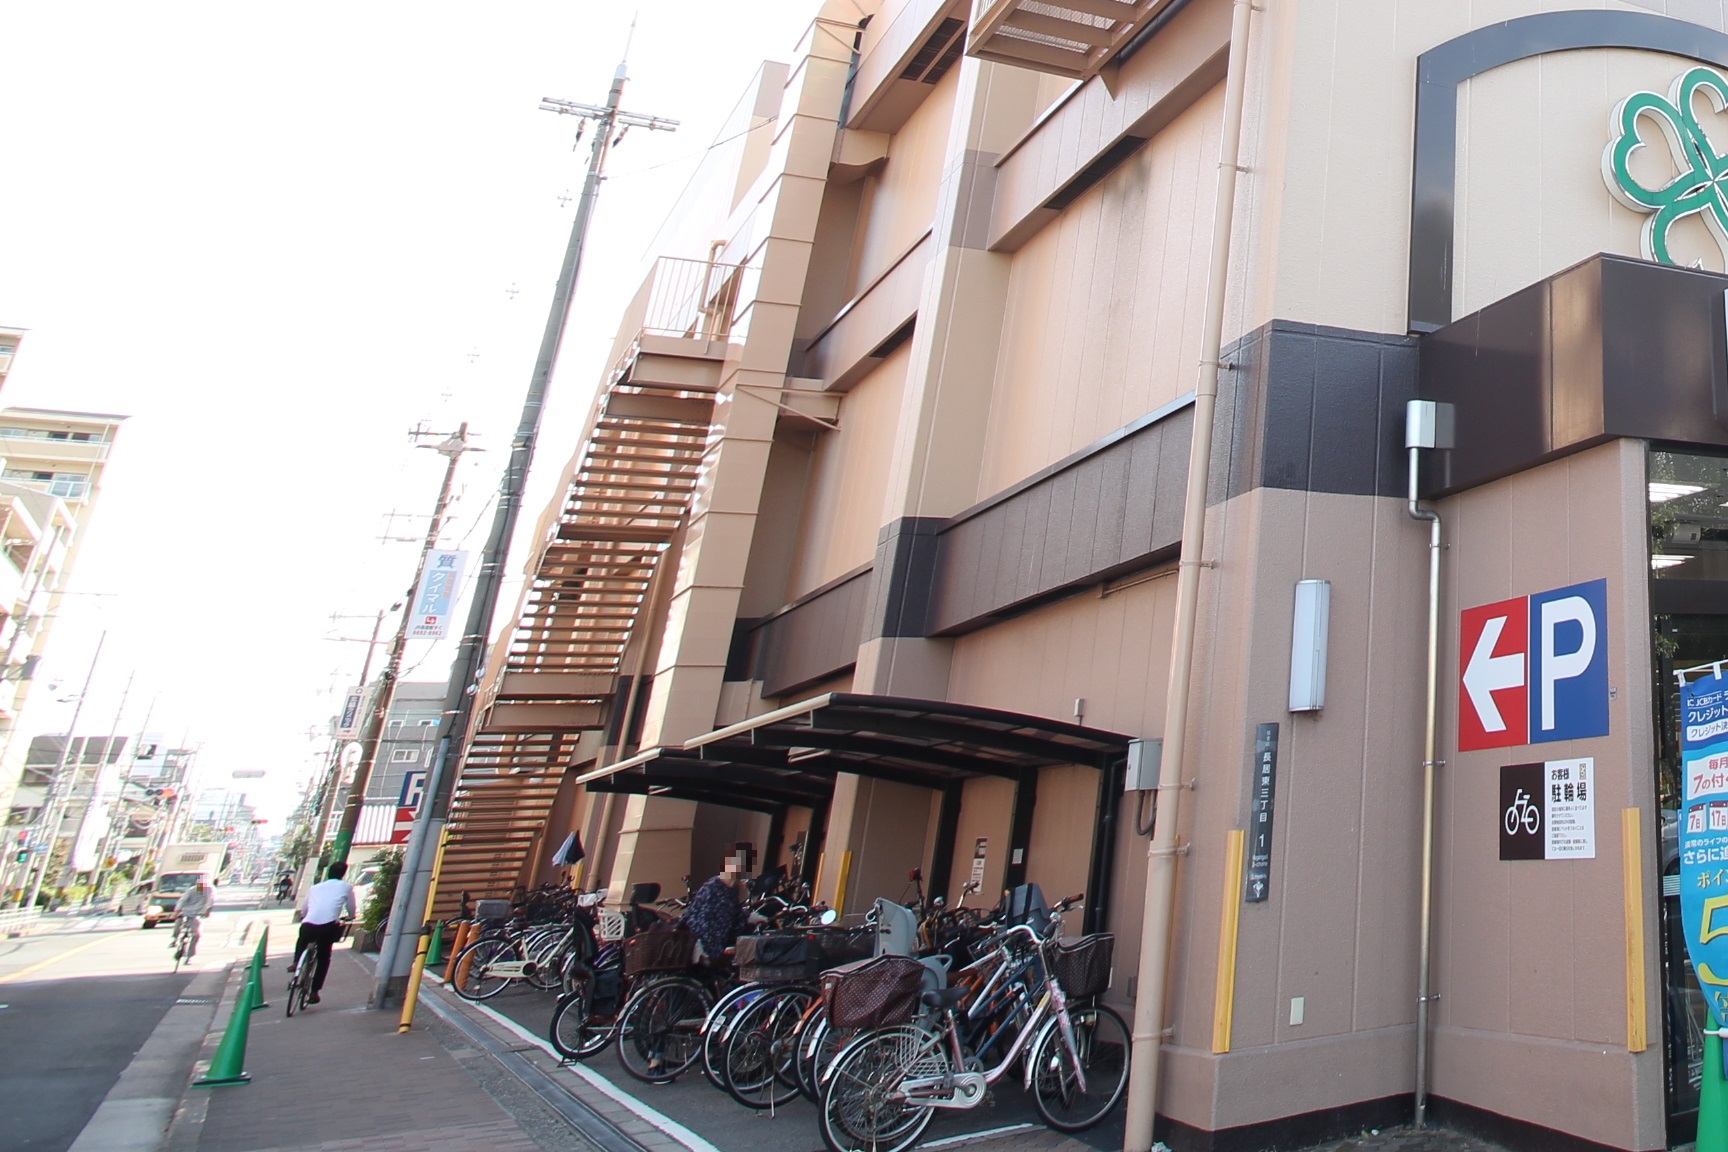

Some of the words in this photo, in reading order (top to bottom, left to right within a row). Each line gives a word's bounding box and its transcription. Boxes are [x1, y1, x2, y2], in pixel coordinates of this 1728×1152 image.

[437, 554, 456, 568] 質
[422, 572, 445, 614] タイマル
[1541, 594, 1597, 730] P
[1709, 756, 1728, 769] 毎月
[1552, 768, 1569, 780] お客様
[1260, 752, 1271, 822] 長居東三丁目
[1552, 782, 1587, 803] 駐輪場
[1690, 814, 1700, 830] 7日
[1711, 810, 1726, 826] 17日
